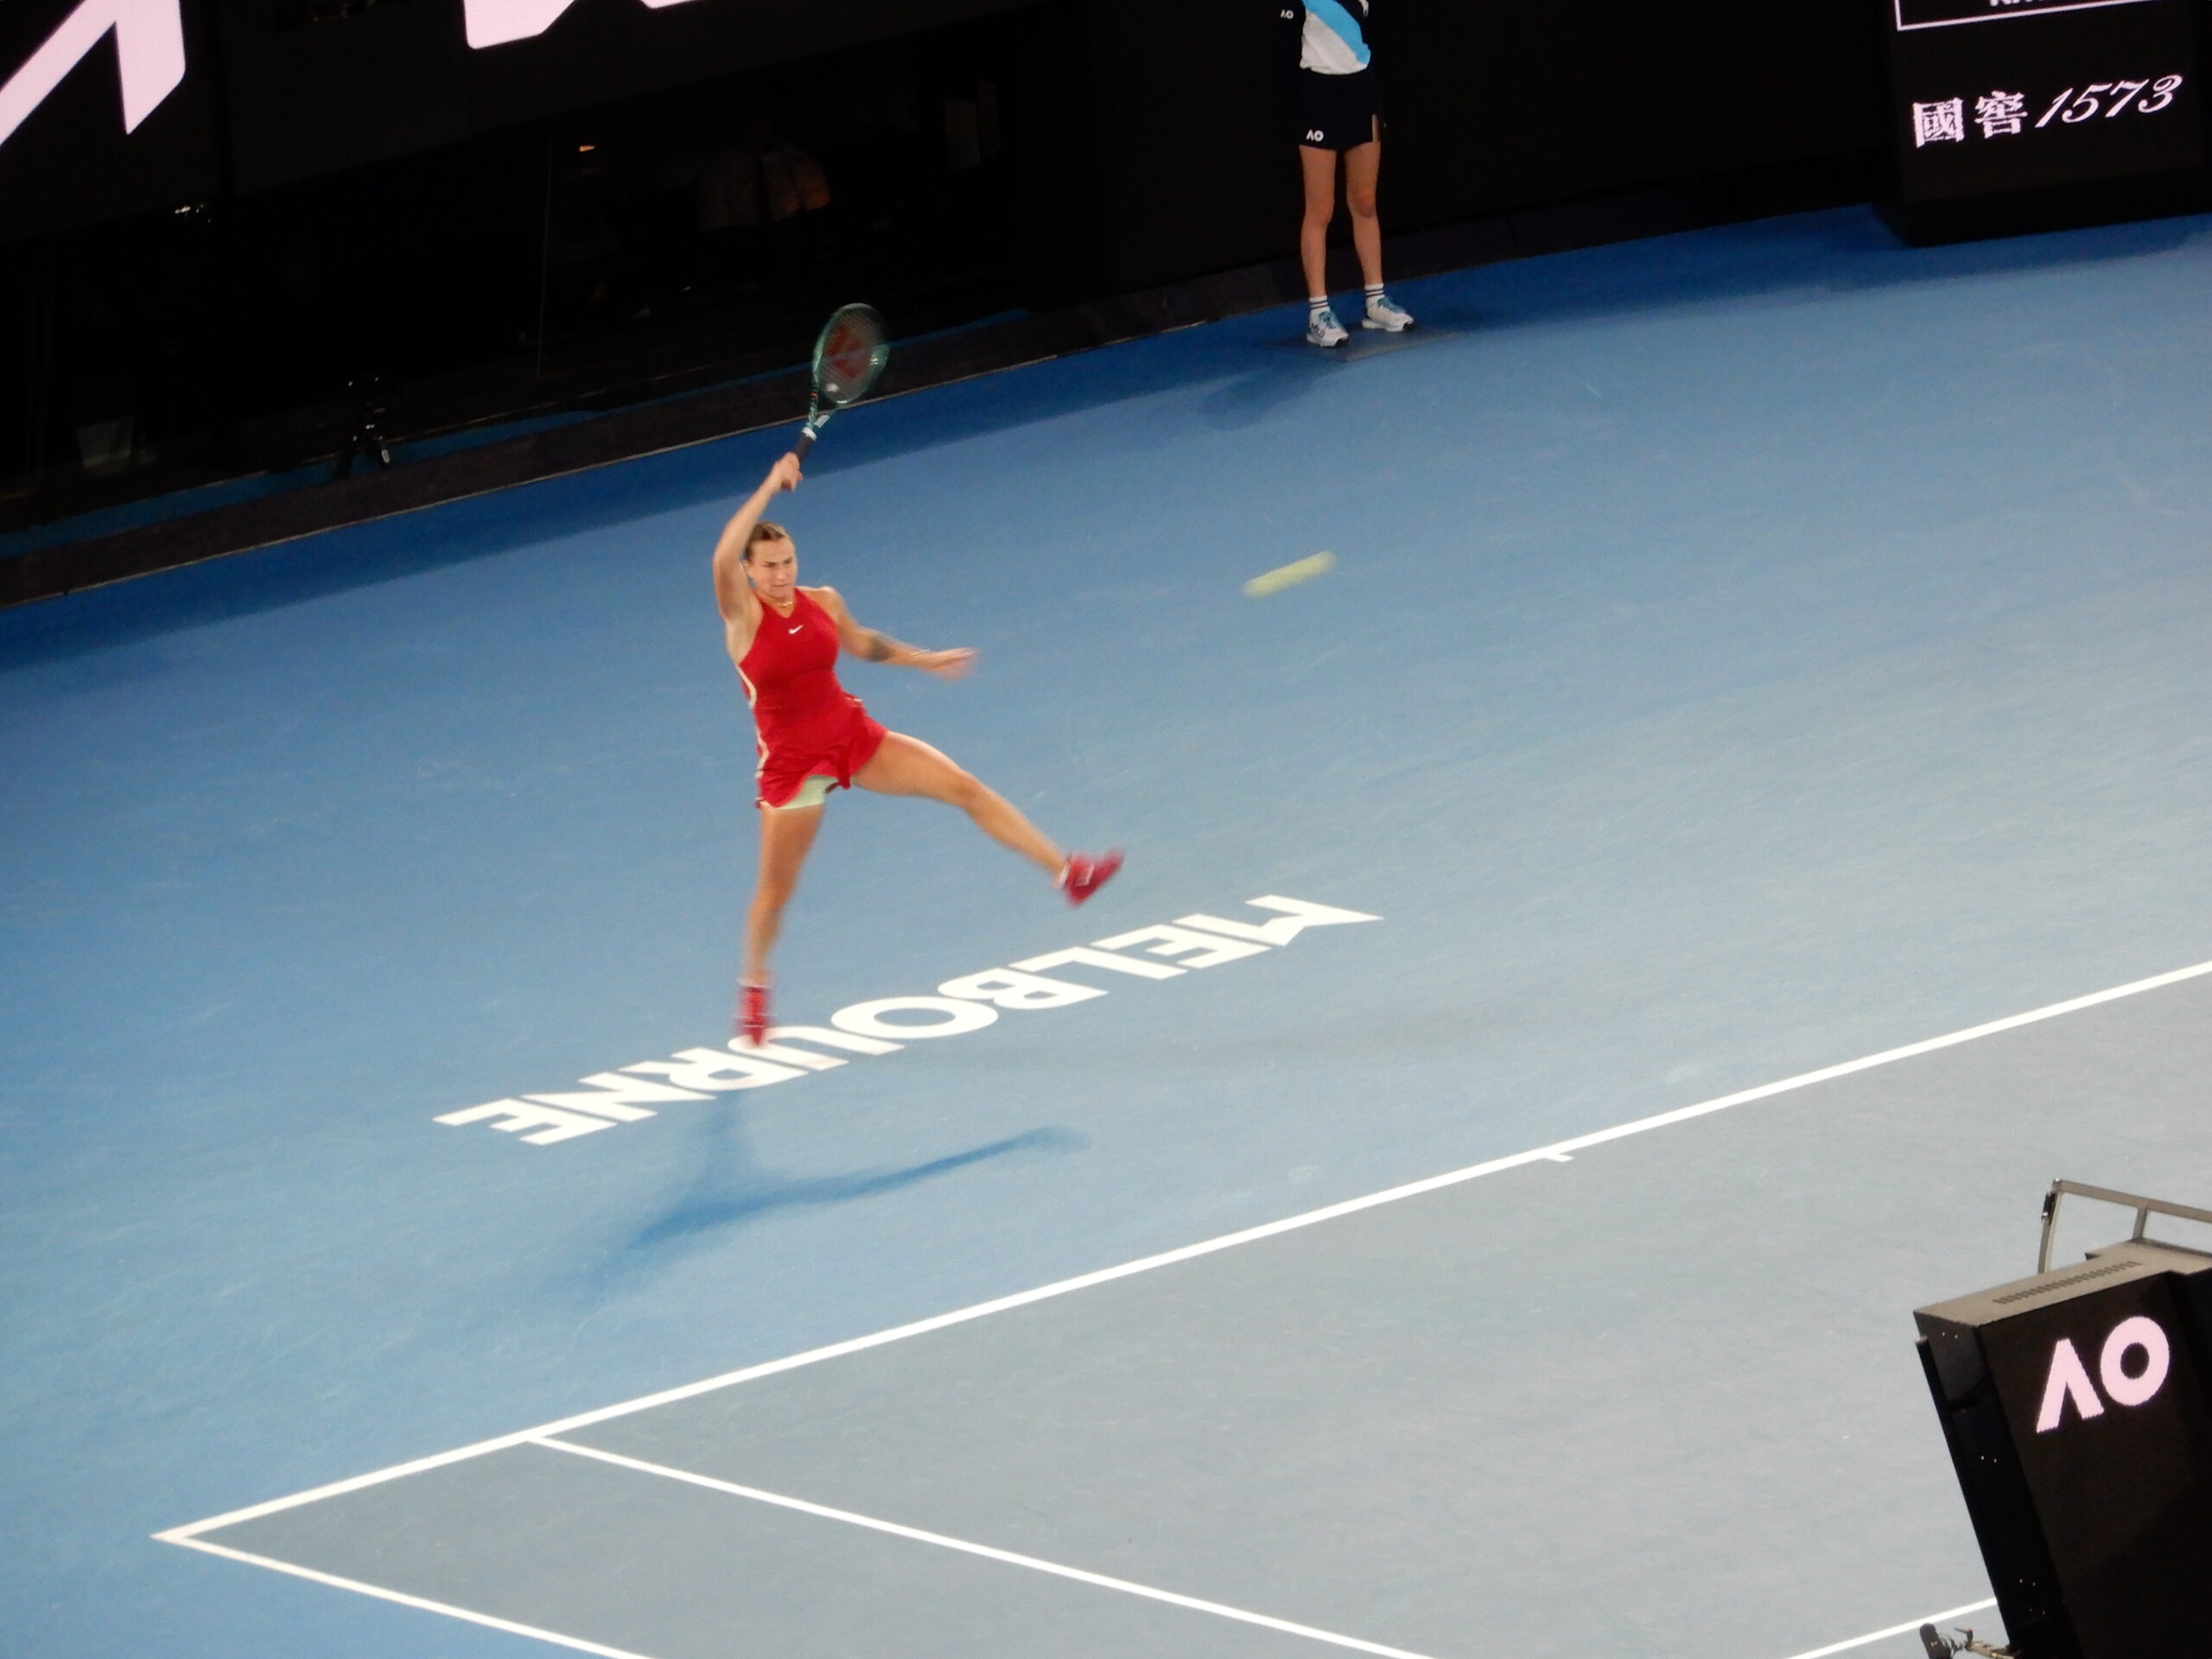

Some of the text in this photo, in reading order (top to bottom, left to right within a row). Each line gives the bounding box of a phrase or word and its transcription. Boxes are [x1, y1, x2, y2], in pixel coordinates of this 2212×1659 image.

[1306, 130, 1325, 142] AO
[433, 894, 1384, 1146] MELBOURNE
[2036, 1316, 2170, 1433] AO
